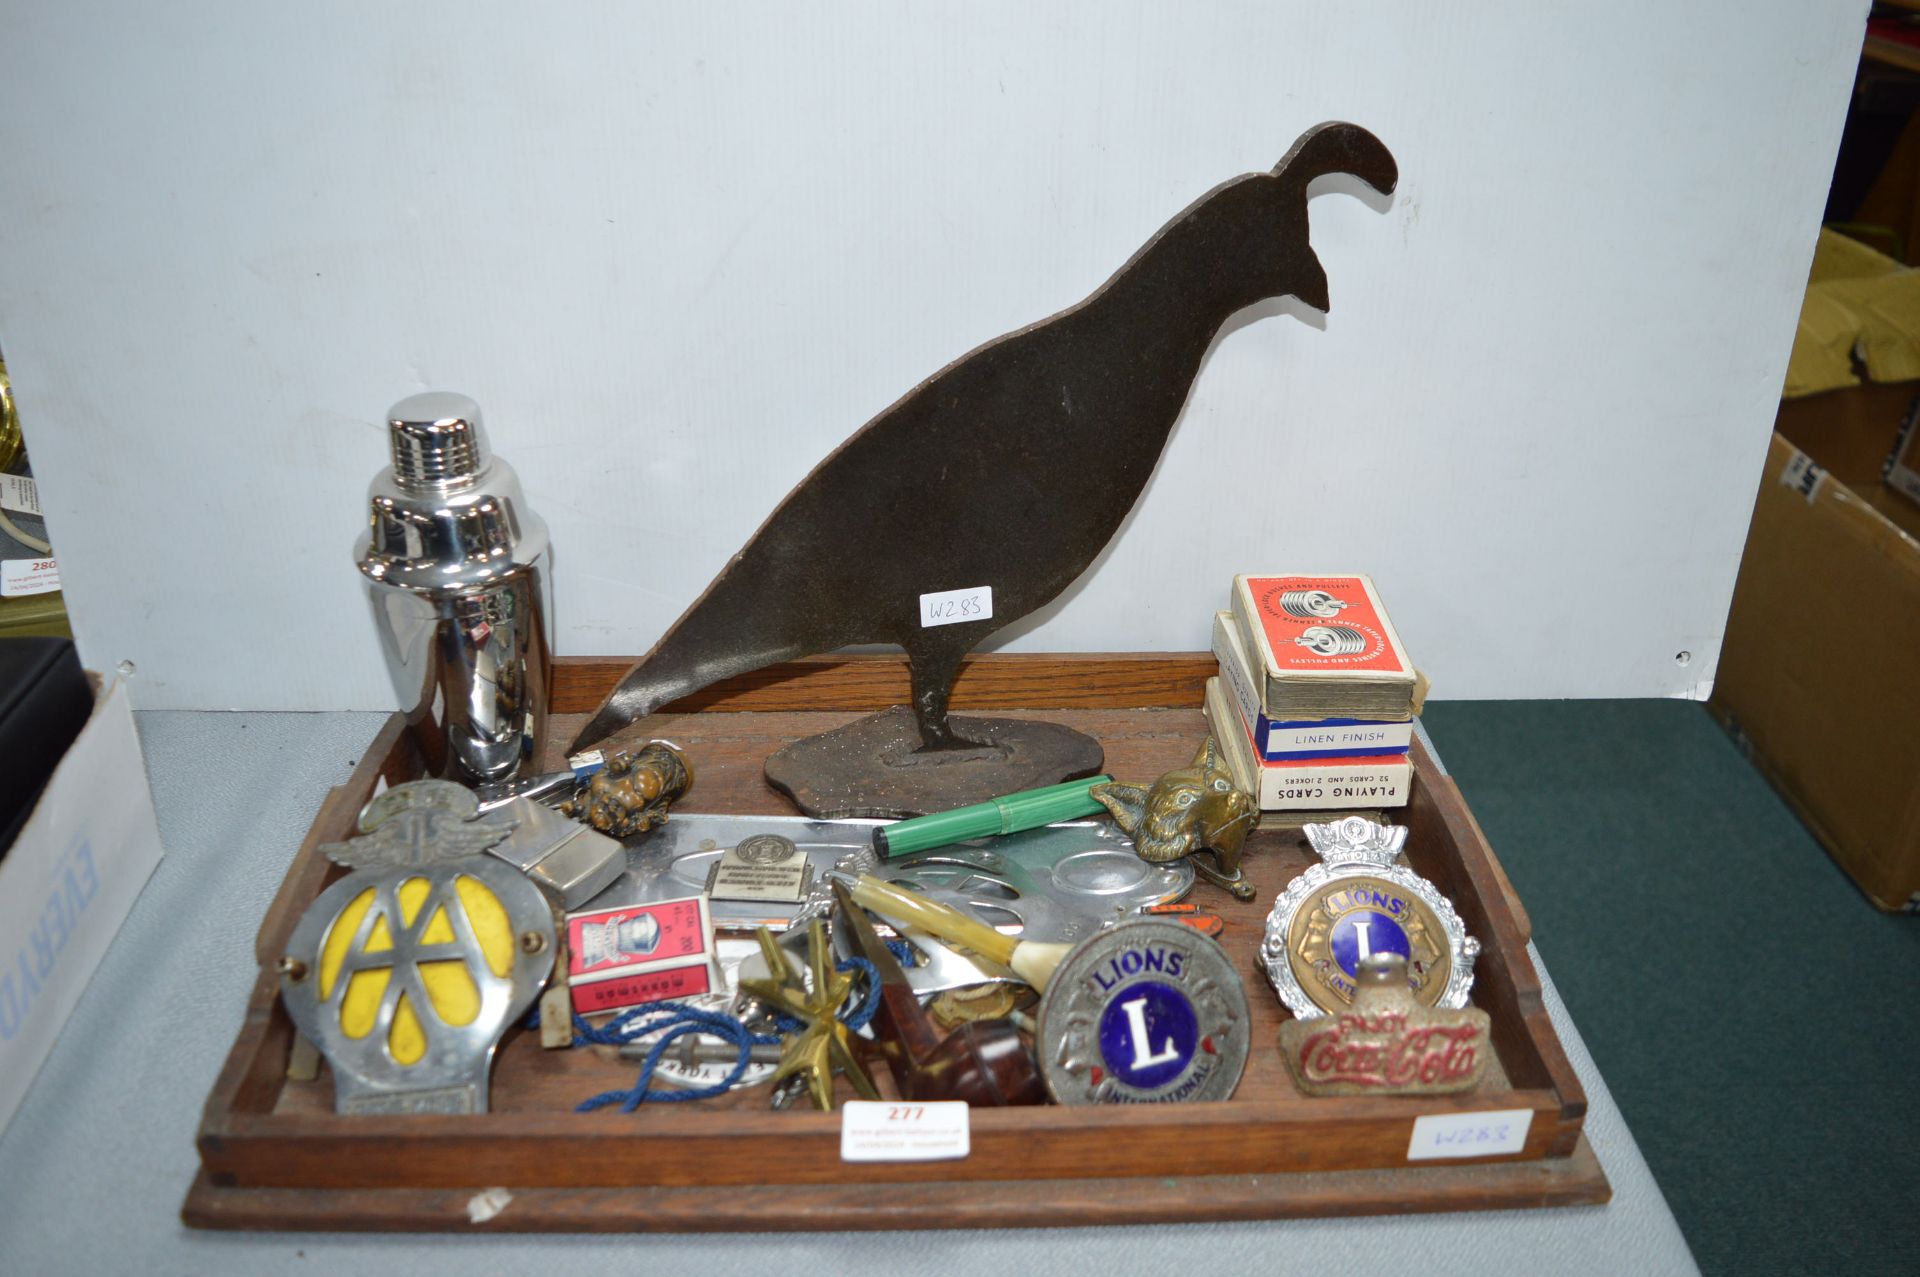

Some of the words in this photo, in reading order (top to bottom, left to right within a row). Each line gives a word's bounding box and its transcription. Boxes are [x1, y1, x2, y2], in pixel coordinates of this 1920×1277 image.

[930, 595, 981, 618] W283
[1295, 734, 1335, 745] LINEN
[1342, 732, 1385, 742] FINISH
[1284, 777, 1314, 785] JOKERS
[1349, 775, 1375, 783] CARDS
[1277, 788, 1323, 800] CARDS
[1332, 786, 1396, 797] PLAYING
[1330, 889, 1405, 915] LIONS
[1093, 947, 1185, 991] LIONS
[1121, 997, 1180, 1071] L
[888, 1106, 925, 1121] 277
